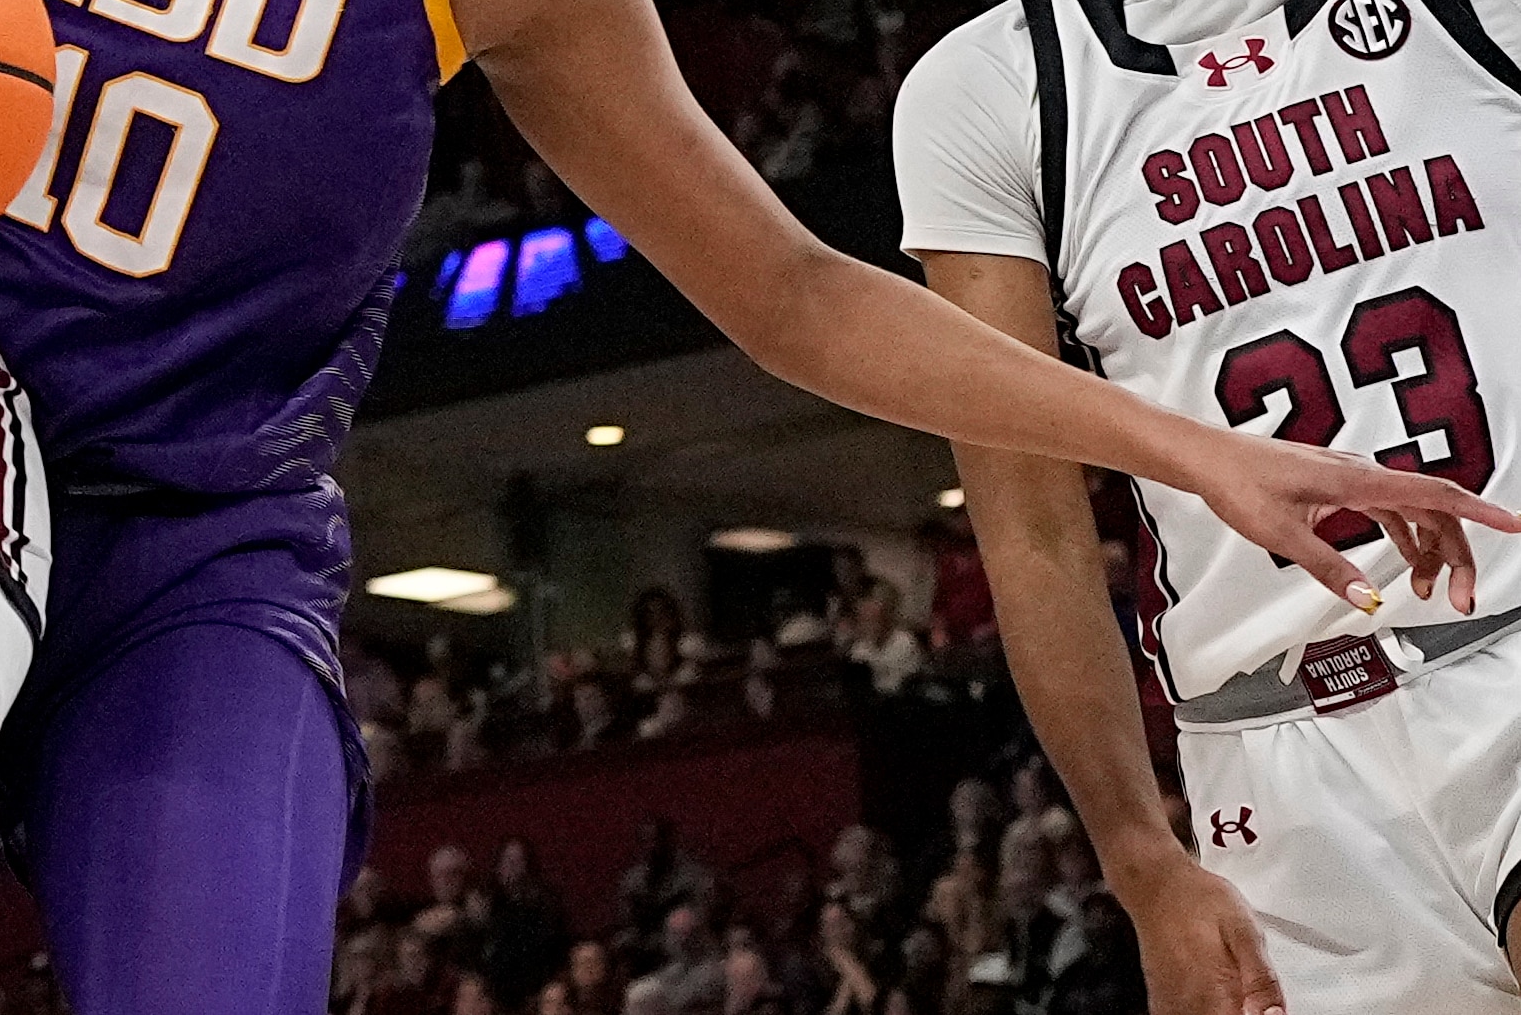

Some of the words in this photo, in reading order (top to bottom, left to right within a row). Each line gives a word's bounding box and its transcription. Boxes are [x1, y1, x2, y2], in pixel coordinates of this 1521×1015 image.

[5, 44, 220, 278] 10
[1141, 84, 1391, 226] SOUTH
[1116, 154, 1486, 341] CAROLINA
[1214, 285, 1496, 569] 23
[1305, 644, 1372, 679] CAROLINA
[1323, 666, 1369, 693] SOUTH
